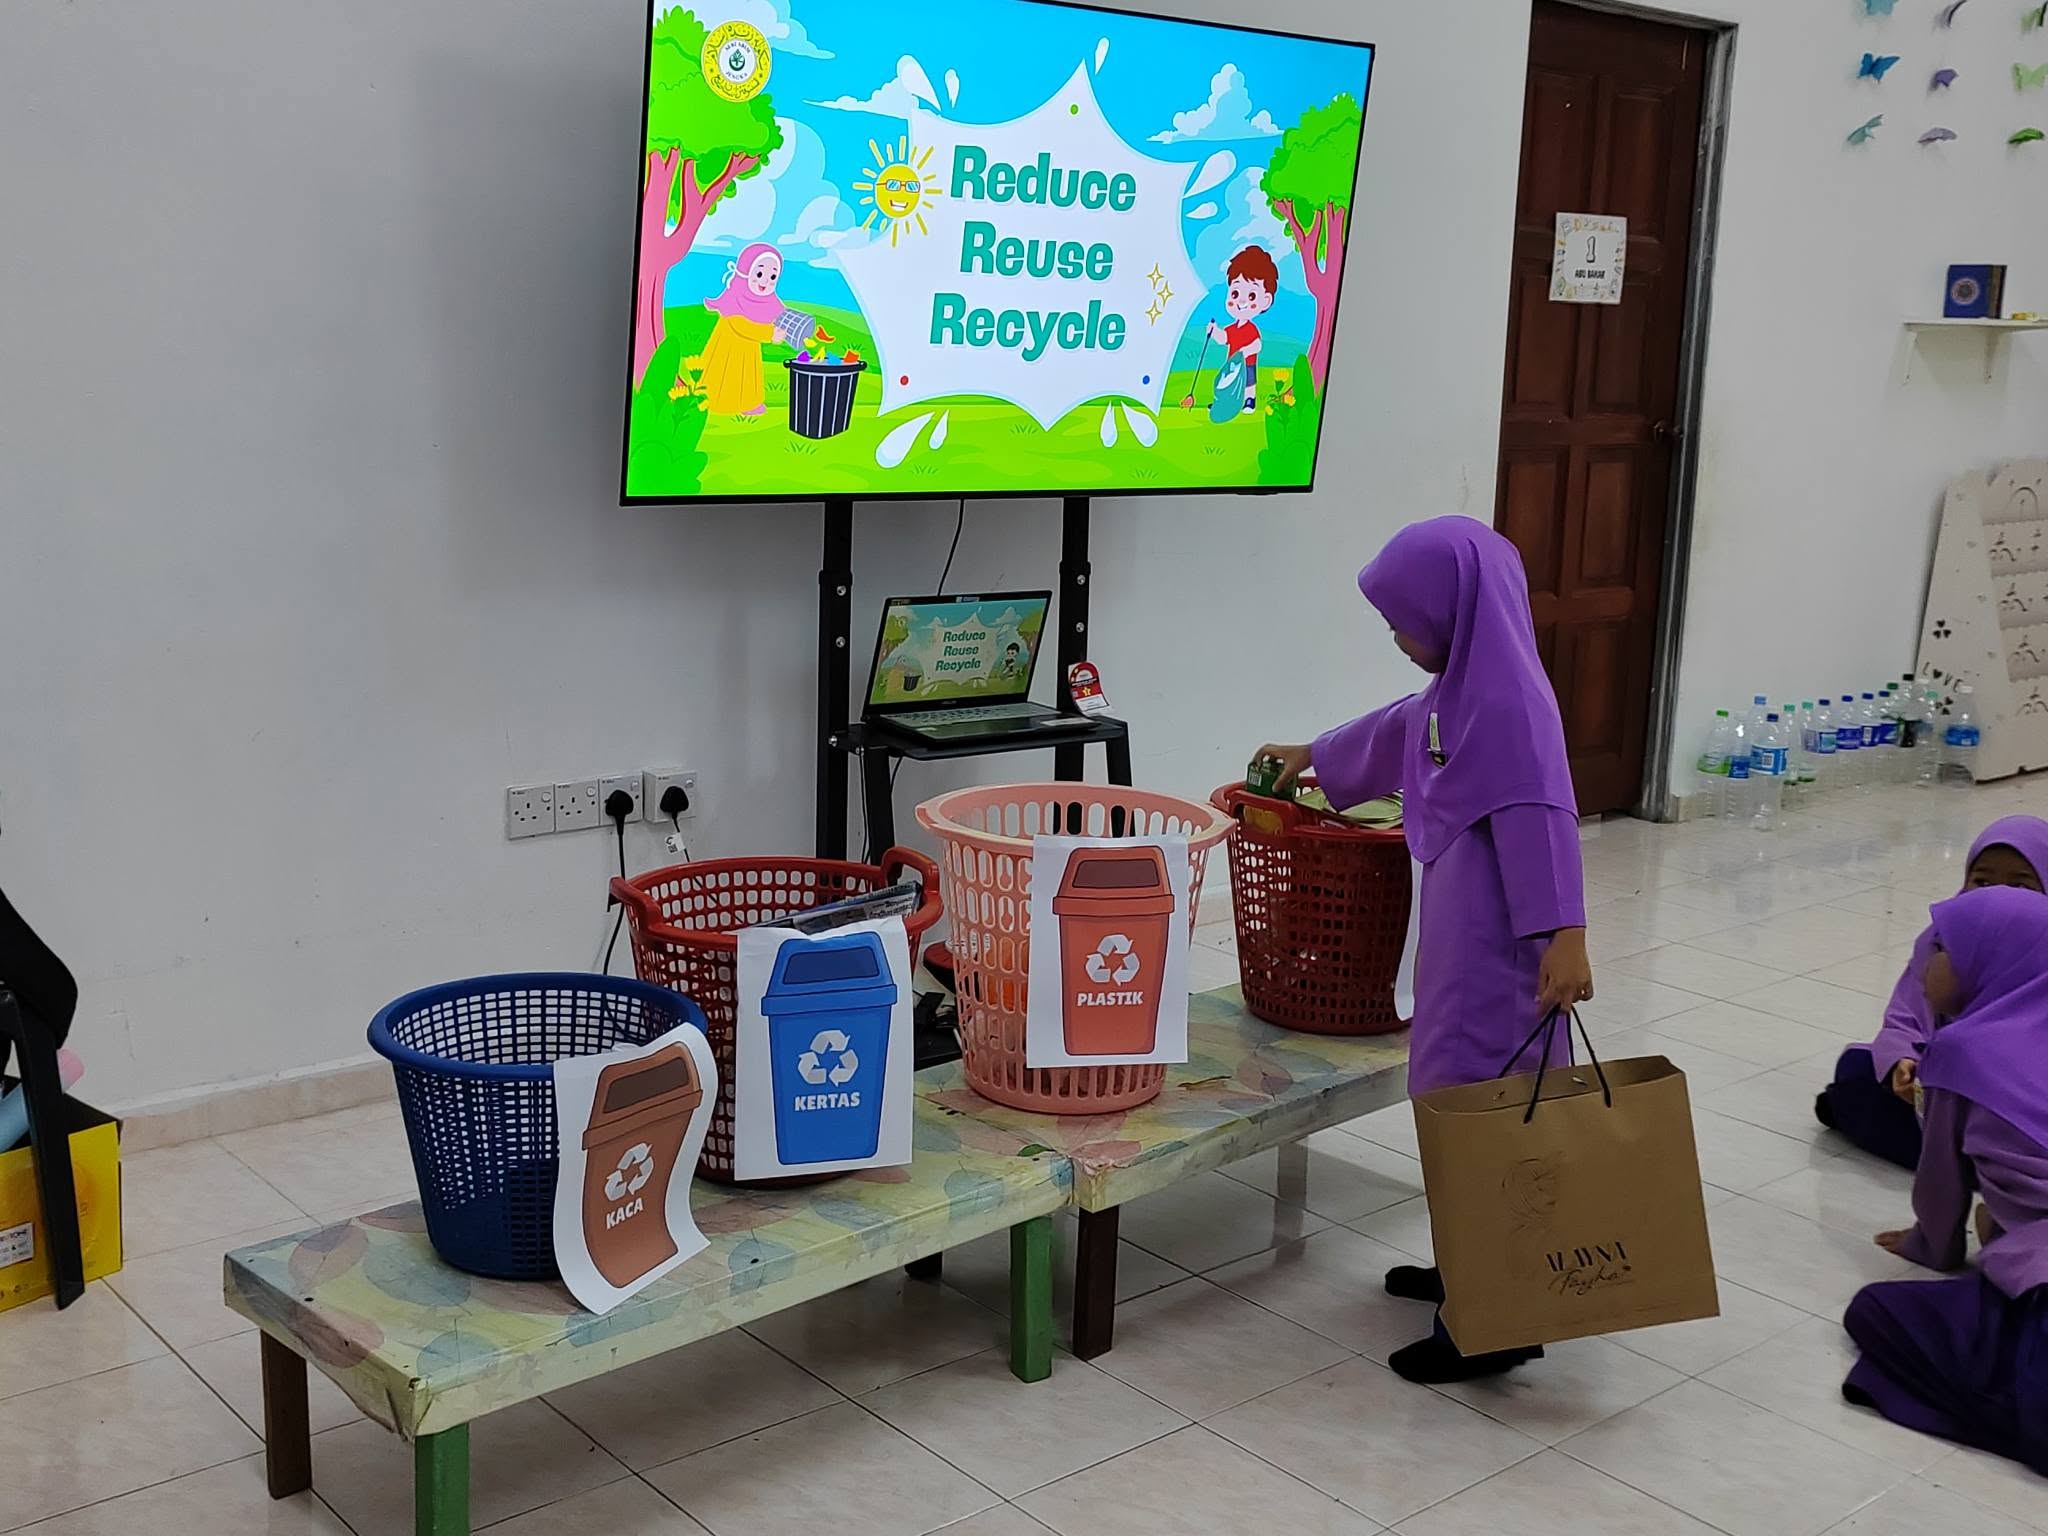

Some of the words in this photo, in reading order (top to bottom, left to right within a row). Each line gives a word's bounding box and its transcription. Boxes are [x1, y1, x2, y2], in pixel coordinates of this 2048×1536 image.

[951, 145, 1136, 211] Reduce
[960, 221, 1113, 281] Reuse
[930, 293, 1126, 361] Recycle
[943, 631, 986, 642] Reduce
[943, 645, 979, 657] Reuse
[935, 658, 981, 672] Recycle
[1077, 991, 1144, 1007] PLASTIK
[794, 1092, 861, 1112] KERTAS
[605, 1197, 644, 1230] KACA
